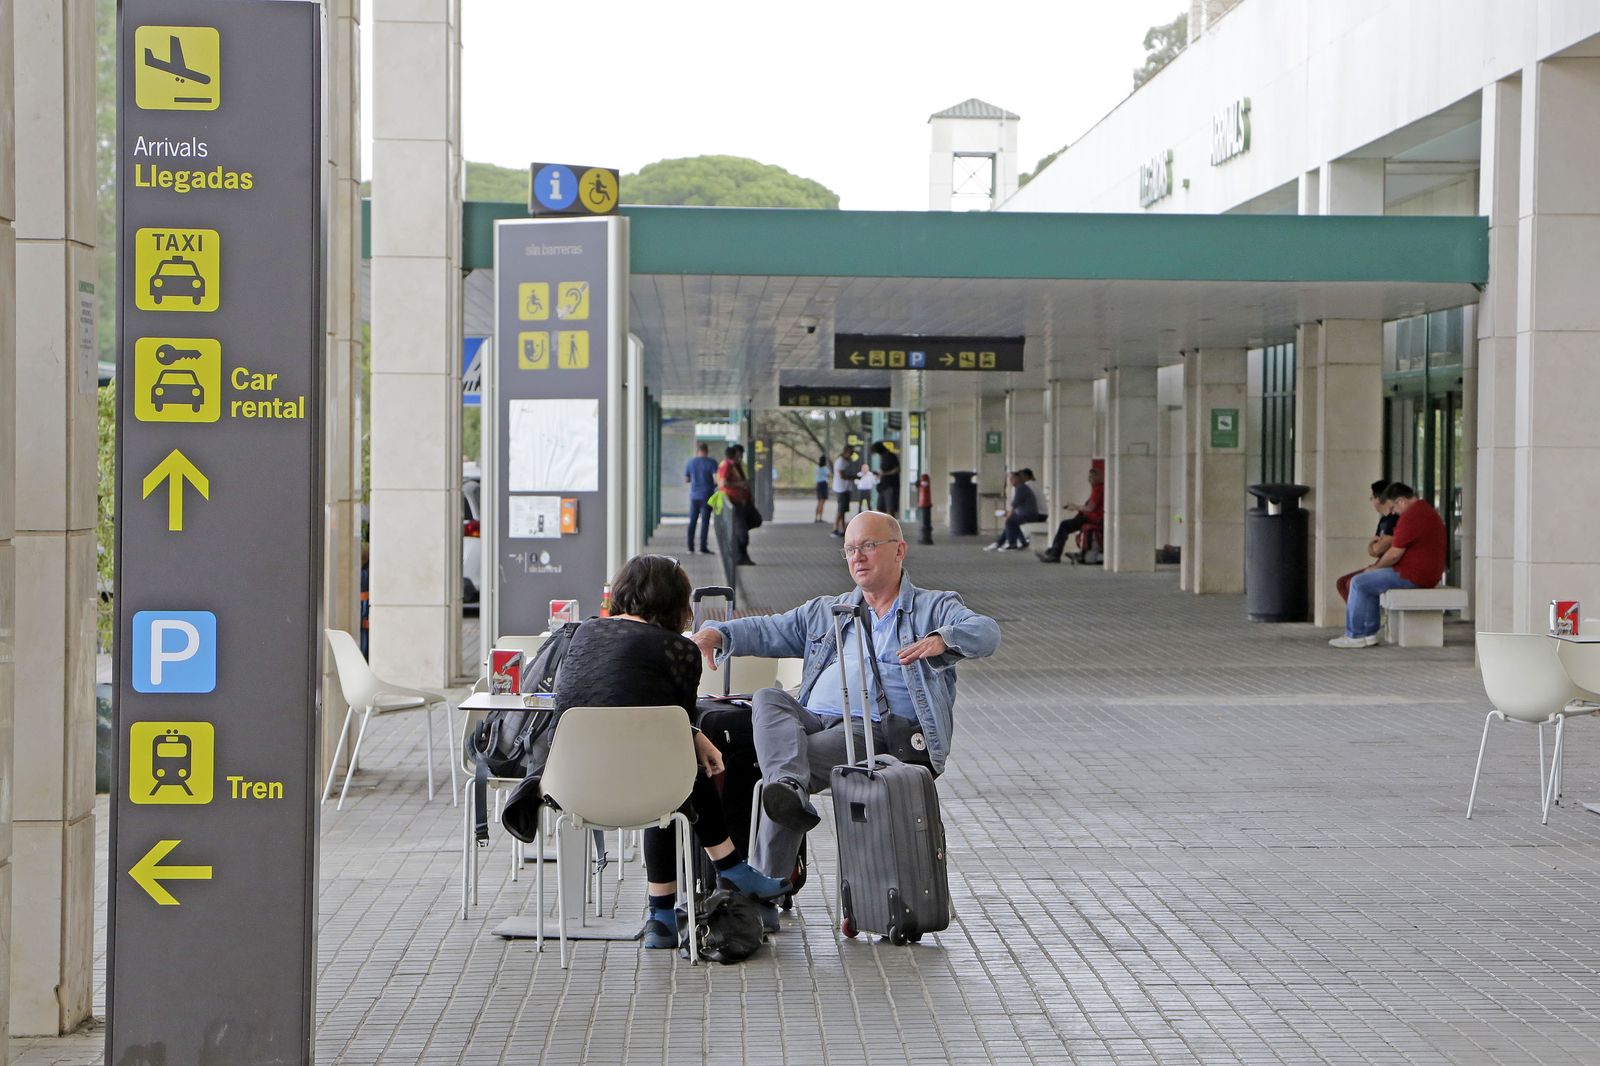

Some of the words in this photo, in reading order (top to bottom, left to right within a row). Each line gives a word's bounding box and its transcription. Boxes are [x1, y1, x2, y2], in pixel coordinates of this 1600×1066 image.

[133, 135, 208, 158] Arrivals
[135, 163, 254, 193] Llegadas
[152, 233, 203, 252] TAXI
[912, 351, 922, 366] P
[231, 367, 278, 391] Car
[231, 396, 305, 419] rental
[150, 619, 200, 685] P
[226, 776, 283, 800] Tren
